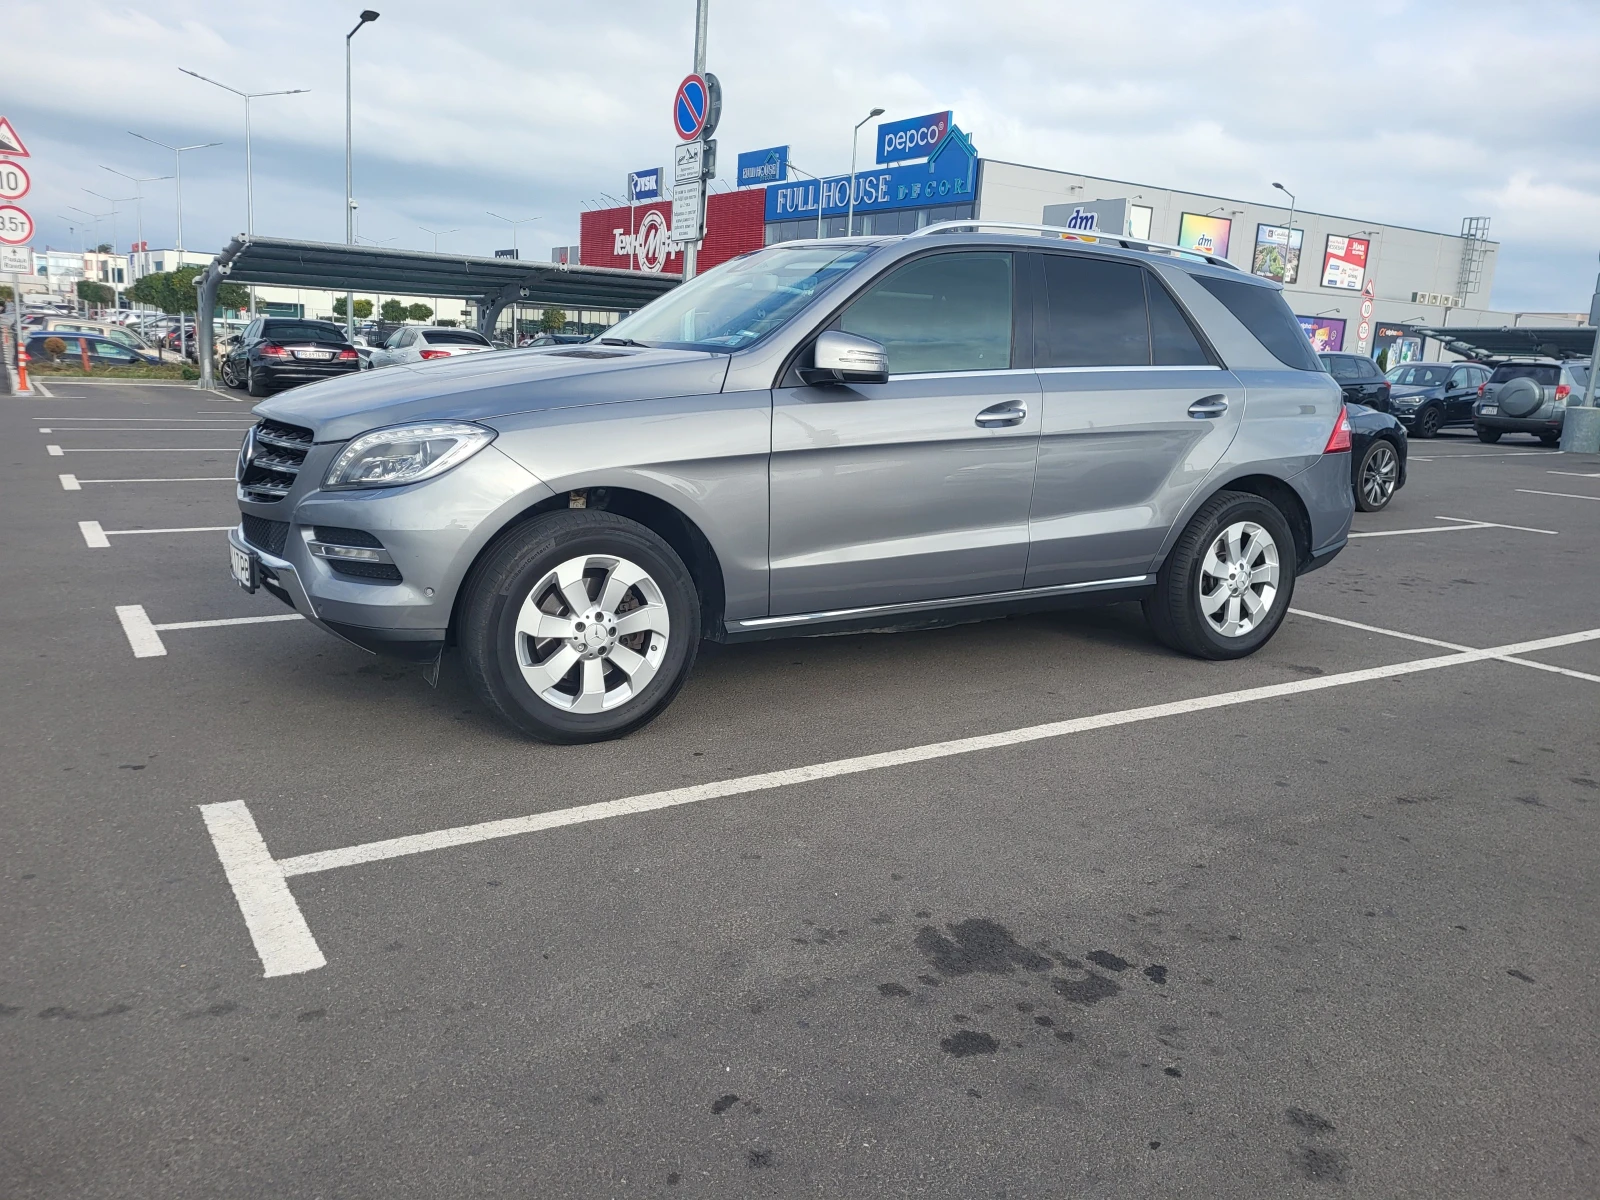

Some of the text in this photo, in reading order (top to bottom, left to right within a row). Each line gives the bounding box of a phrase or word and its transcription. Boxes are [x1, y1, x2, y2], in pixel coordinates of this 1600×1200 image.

[636, 175, 657, 192] JYSK
[777, 174, 968, 214] FULL HOUSE DECOR
[1068, 209, 1096, 231] dm
[1198, 234, 1212, 247] dm
